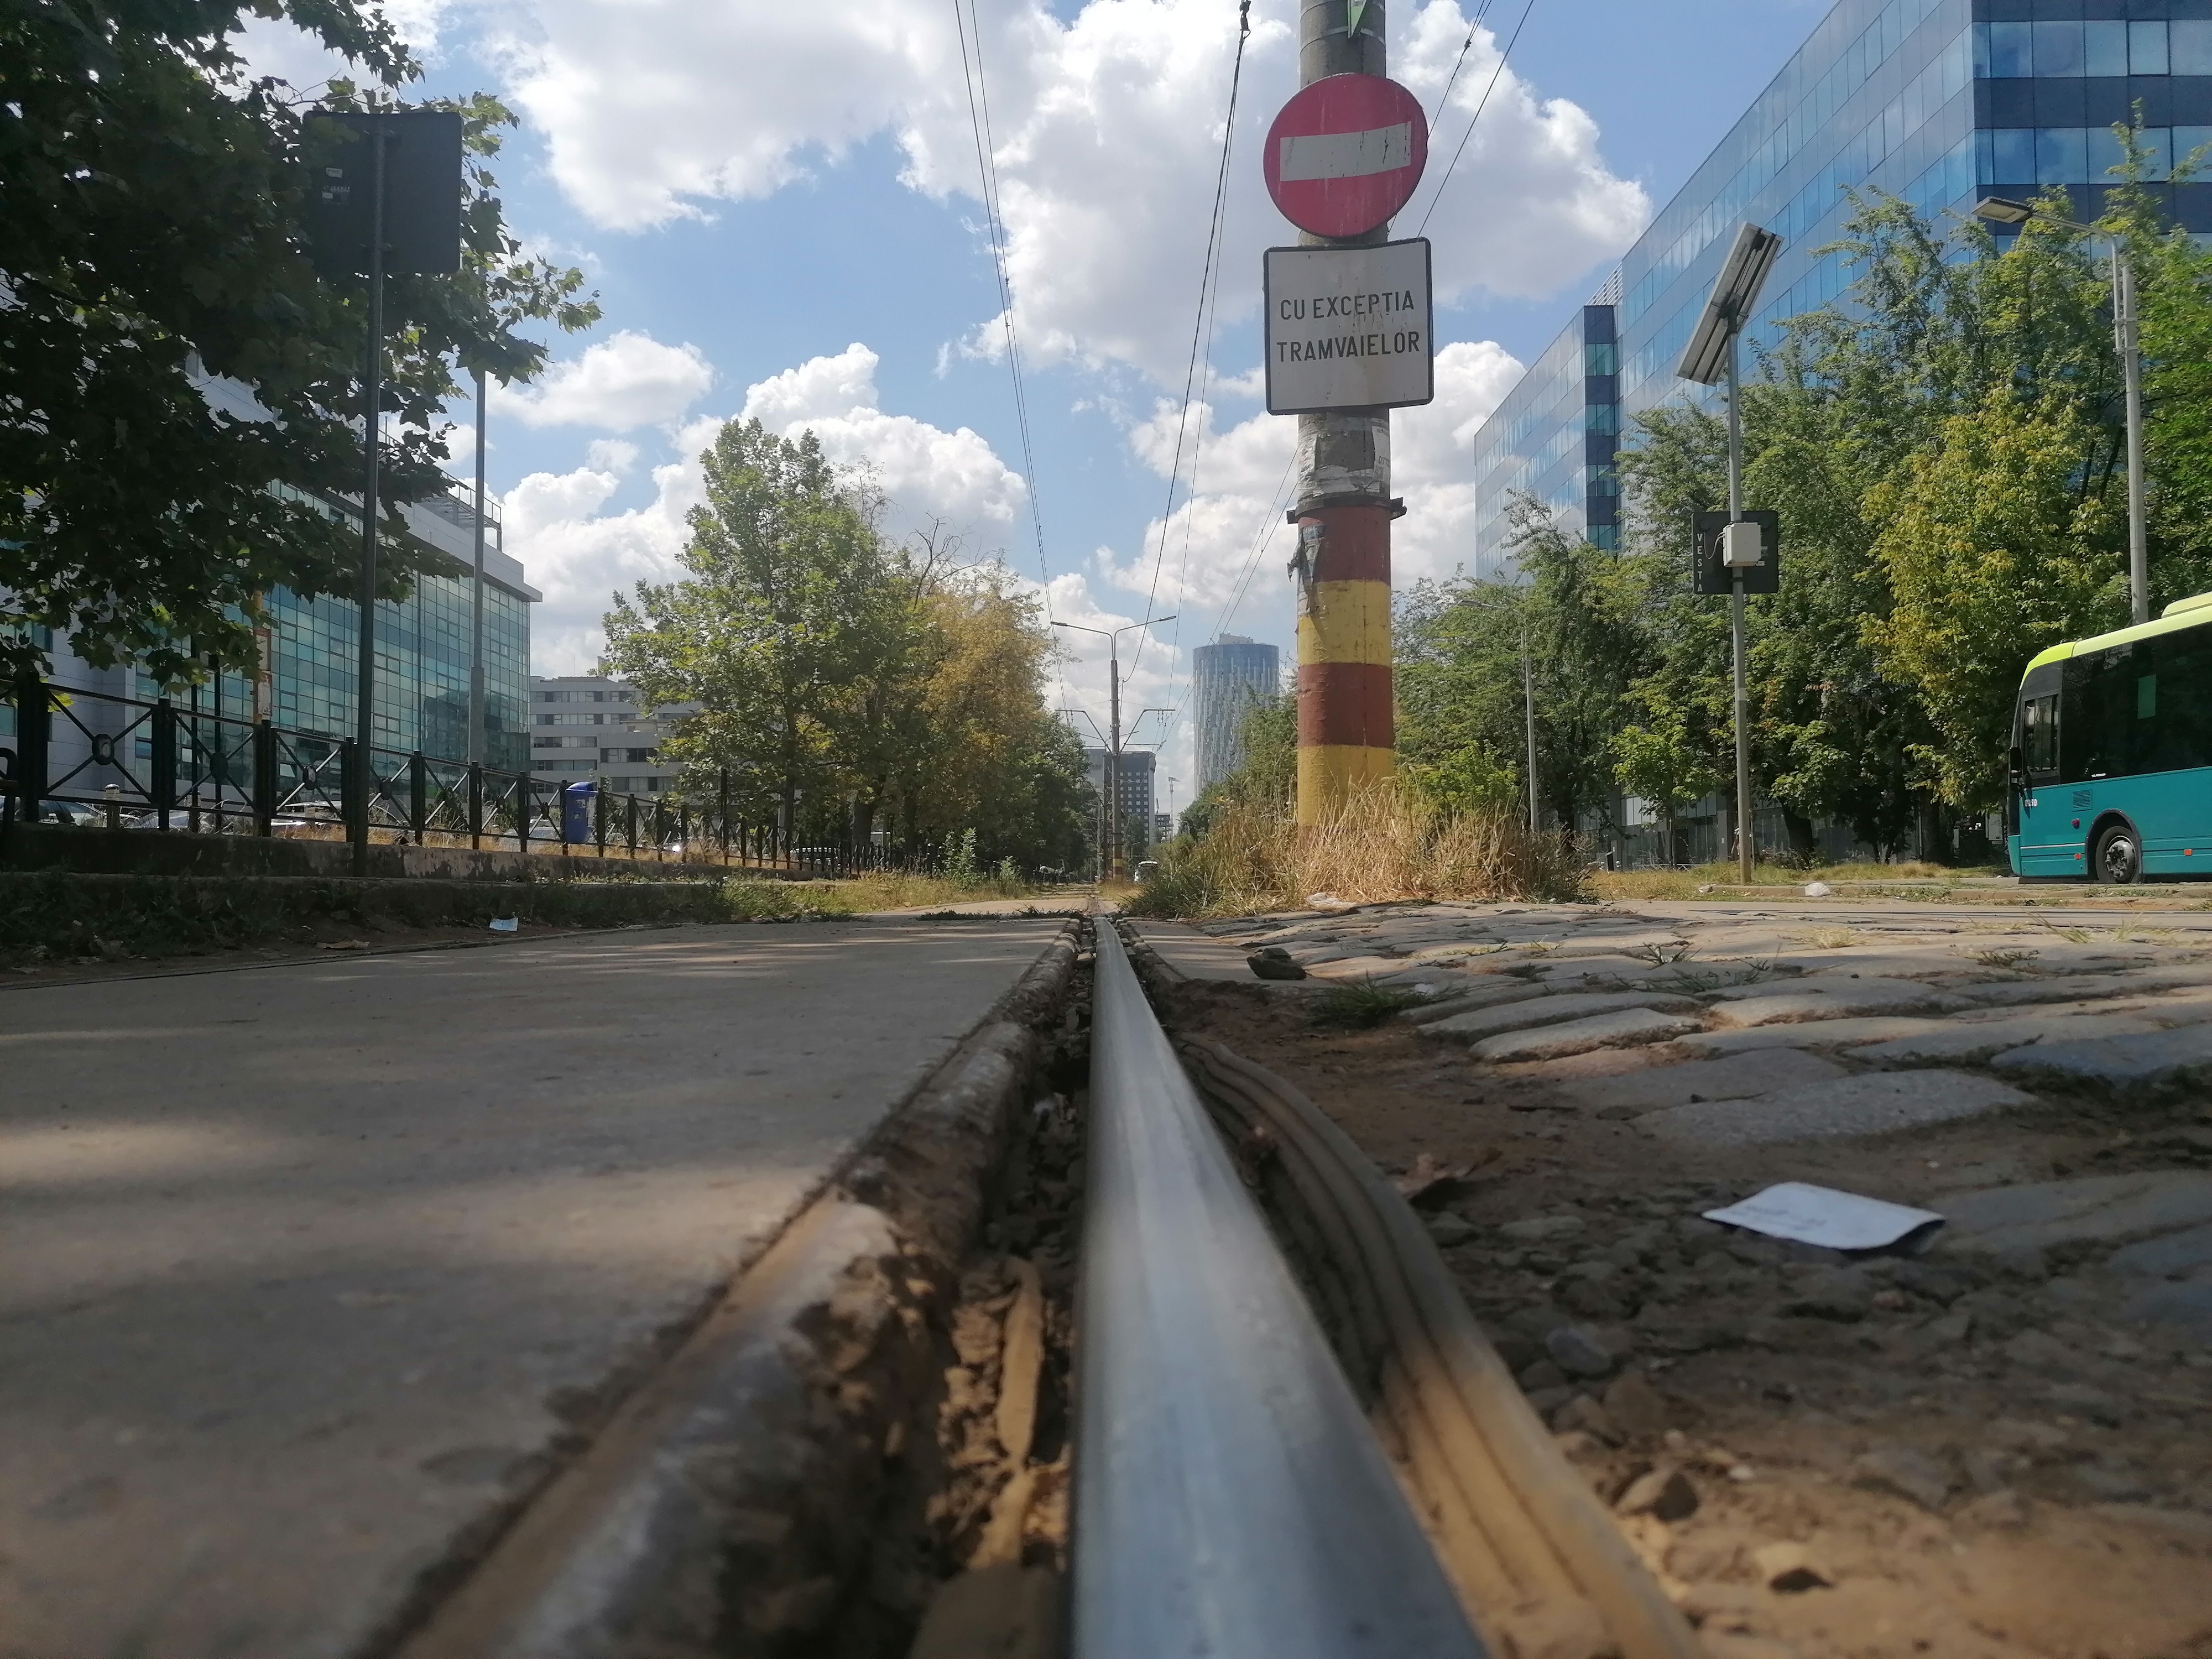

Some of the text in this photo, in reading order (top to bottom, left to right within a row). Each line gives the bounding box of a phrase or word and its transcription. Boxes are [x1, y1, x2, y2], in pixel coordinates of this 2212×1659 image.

[1280, 290, 1415, 320] CU EXCEPTIA
[1276, 331, 1420, 362] TRAMVAIELOR
